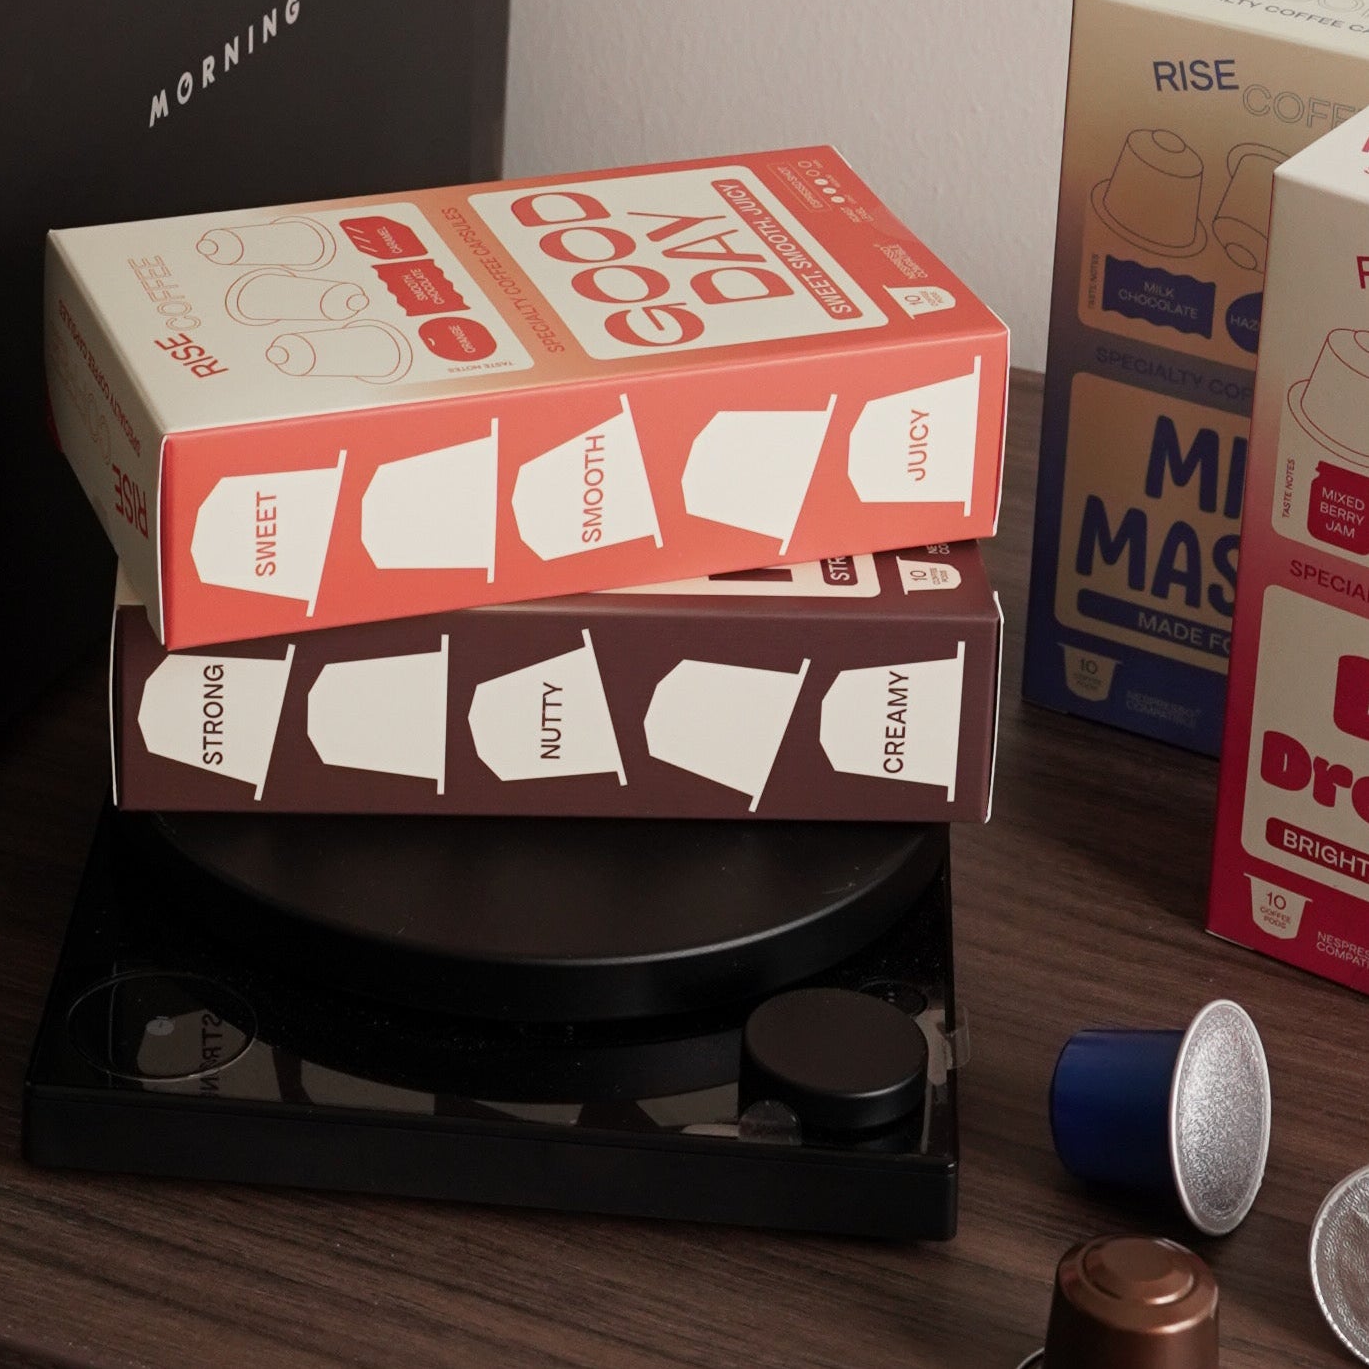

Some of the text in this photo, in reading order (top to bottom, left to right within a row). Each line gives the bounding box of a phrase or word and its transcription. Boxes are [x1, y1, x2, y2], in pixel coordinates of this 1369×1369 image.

[1264, 4, 1344, 30] COFFEE
[1152, 59, 1239, 92] RISE
[377, 226, 403, 254] CARAMEL
[626, 211, 795, 305] DAY
[718, 183, 853, 314] SWEET, SMOOTH, JUICY
[402, 274, 428, 301] SMOOTH
[410, 268, 445, 305] CHOCOLATE
[441, 207, 566, 353] SPECIALTY COFFEE CAPSULES
[511, 192, 705, 347] GOOD
[904, 294, 923, 305] 10
[1118, 288, 1199, 319] CHOCOLATE
[1143, 282, 1175, 297] MILK
[127, 255, 229, 379] RISE COFFEE
[448, 325, 476, 353] ORANGE
[1095, 346, 1203, 385] SPECIALTY
[907, 409, 930, 482] JUICY
[112, 463, 148, 539] RISE
[582, 434, 606, 544] SMOOTH
[1282, 458, 1296, 519] TASTE NOTES
[1322, 486, 1366, 511] MIXED
[1319, 501, 1365, 526] BERRY
[1325, 522, 1355, 539] JAM
[255, 491, 278, 576] SWEET
[910, 570, 927, 581] 10
[1138, 612, 1204, 645] MADE
[1080, 658, 1098, 674] 10
[202, 664, 224, 766] STRONG
[540, 682, 563, 760] NUTTY
[883, 670, 910, 774] CREAMY
[1283, 829, 1369, 877] BRIGHT
[1267, 892, 1286, 910] 10
